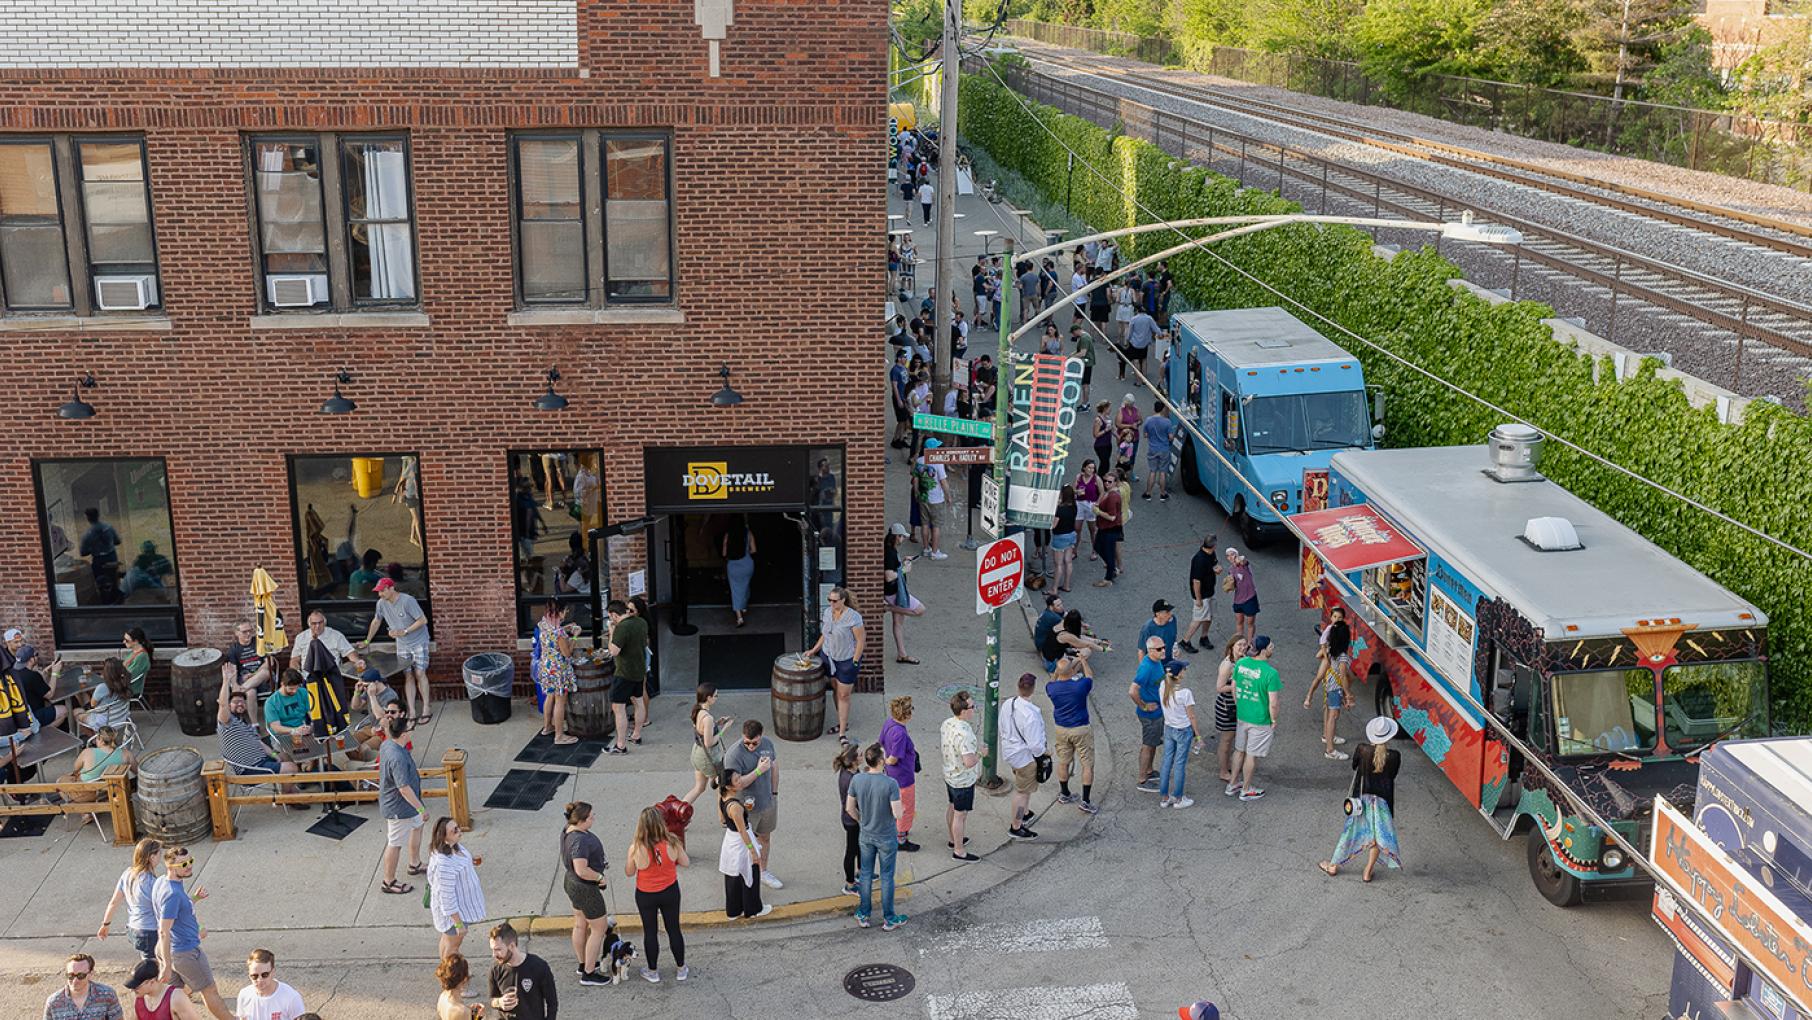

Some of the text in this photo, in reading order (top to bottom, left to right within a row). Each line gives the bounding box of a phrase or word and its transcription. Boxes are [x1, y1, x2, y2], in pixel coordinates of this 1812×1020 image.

[924, 416, 948, 431] BELLE
[951, 419, 979, 435] PLAINE
[682, 473, 775, 487] DOVETAIL
[984, 548, 1017, 570] DO NOT
[988, 579, 1014, 598] ENTER
[1665, 824, 1725, 921] Happy
[1729, 882, 1797, 974] Lobster
